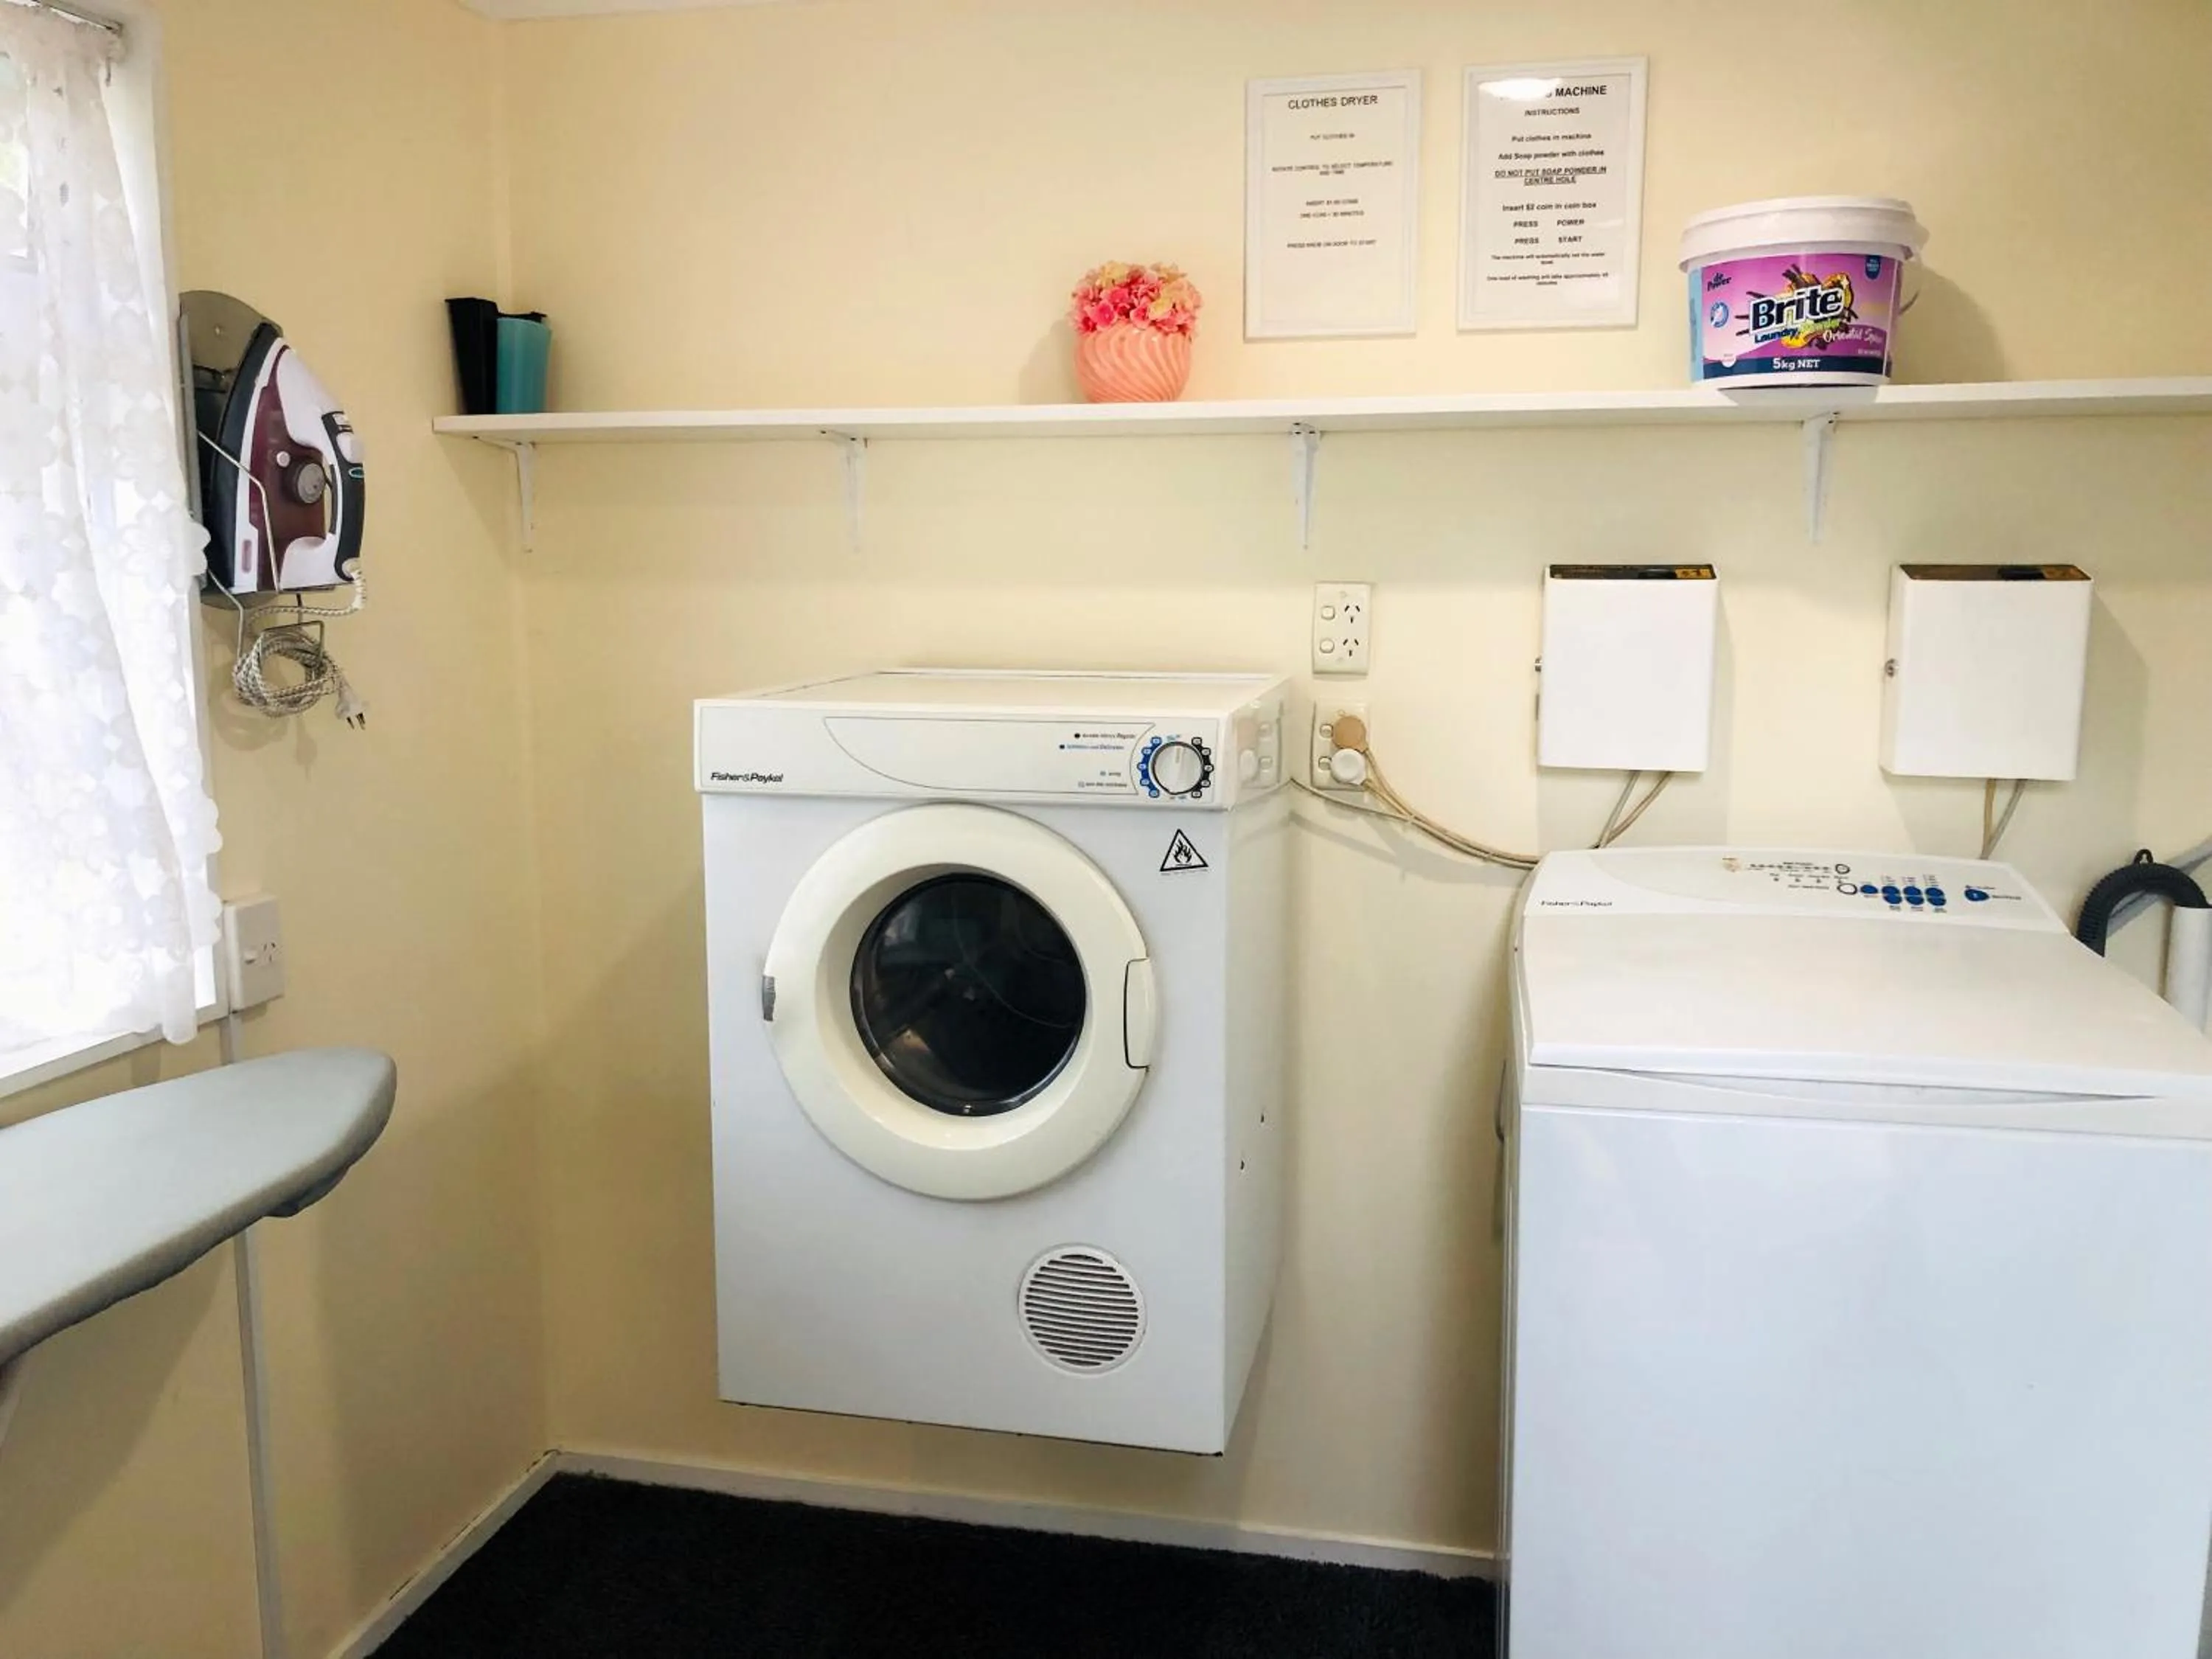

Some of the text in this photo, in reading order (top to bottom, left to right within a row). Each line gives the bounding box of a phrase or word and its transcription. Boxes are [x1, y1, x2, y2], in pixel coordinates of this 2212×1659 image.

[1555, 85, 1607, 97] MACHINE
[1288, 95, 1378, 110] CLOTHES DRYER
[1525, 107, 1580, 116] INSTRUCTIONS
[1526, 133, 1551, 142] clothes
[1498, 152, 1512, 160] Add
[1514, 153, 1532, 161] Soap
[1534, 151, 1559, 159] powder
[1561, 150, 1576, 158] with
[1495, 166, 1607, 178] DO NOT PUT SOAP POWDER IN
[1524, 176, 1576, 186] CENTRE HOLE
[1502, 204, 1524, 212] Insert
[1526, 203, 1534, 211] $2
[1536, 203, 1554, 211] coin
[1557, 218, 1585, 226] POWER
[1558, 235, 1583, 243] START
[1751, 288, 1843, 332] Brite
[1754, 327, 1798, 344] Laundry
[1773, 357, 1821, 370] 5kg NET
